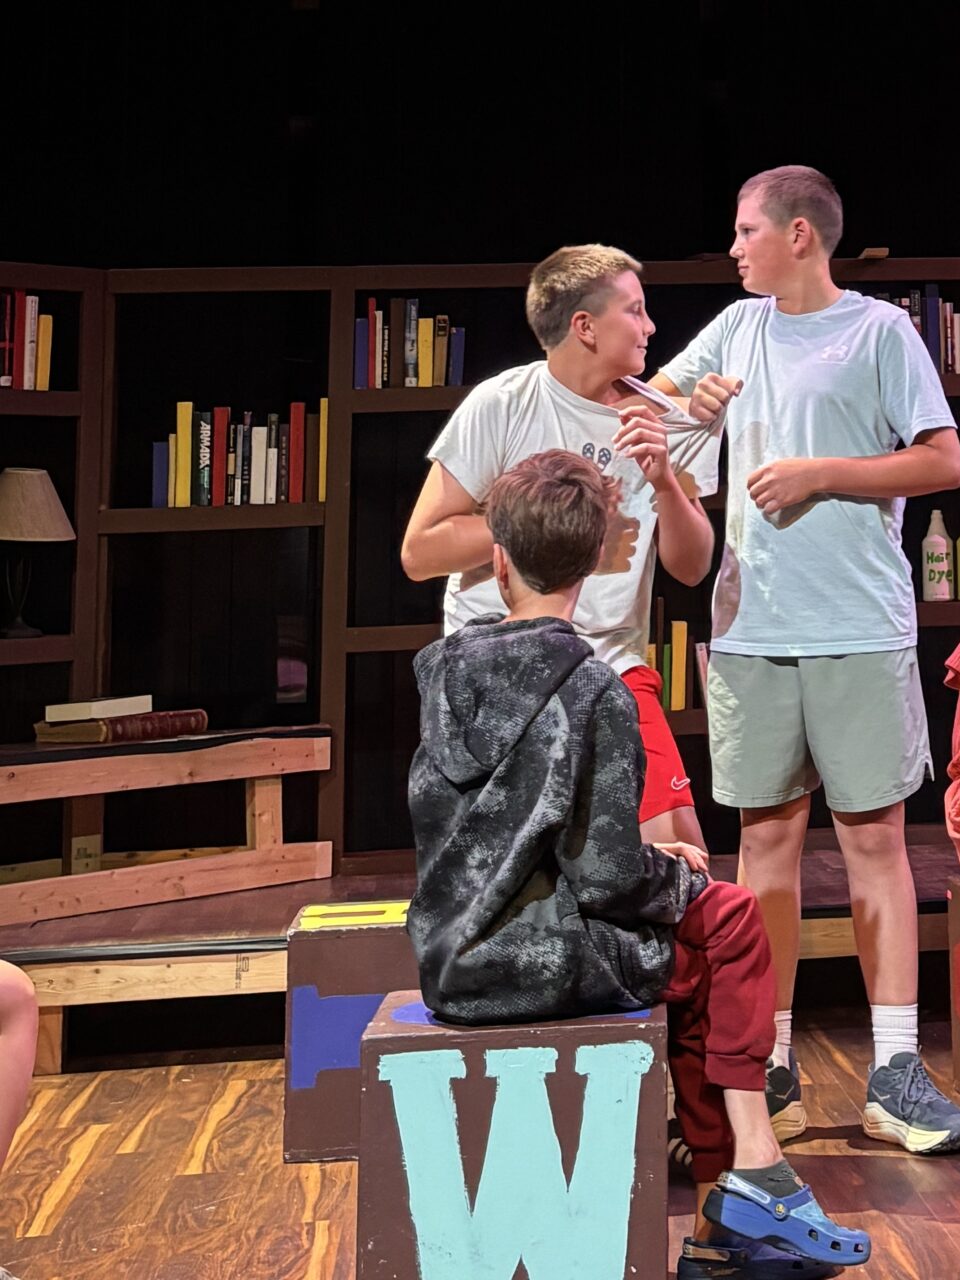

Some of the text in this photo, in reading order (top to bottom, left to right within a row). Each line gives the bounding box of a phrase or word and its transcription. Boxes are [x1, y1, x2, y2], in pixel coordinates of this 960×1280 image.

[199, 421, 211, 469] ARMADA
[926, 552, 950, 564] Hair
[928, 569, 952, 583] Dye
[377, 1039, 655, 1280] W
